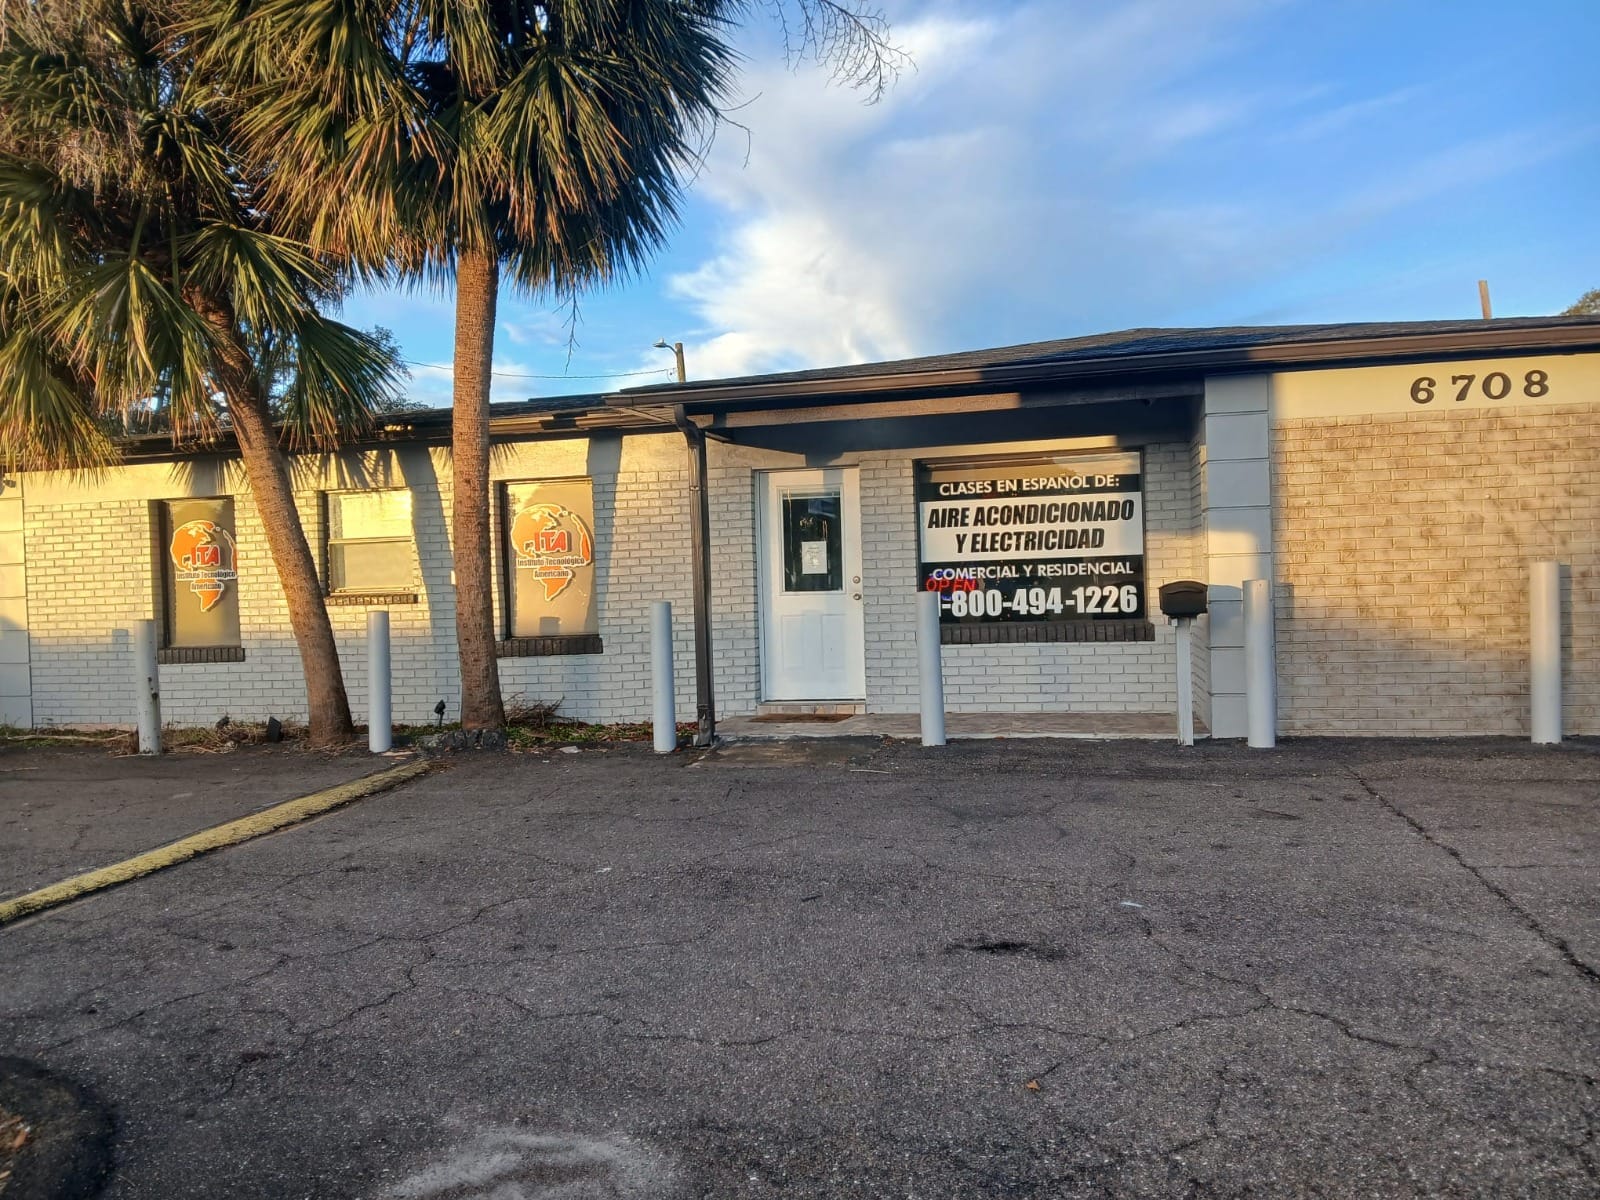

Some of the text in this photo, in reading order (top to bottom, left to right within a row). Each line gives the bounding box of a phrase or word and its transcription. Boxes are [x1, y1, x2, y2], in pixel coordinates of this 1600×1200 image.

[1410, 369, 1549, 404] 6708
[939, 473, 1120, 496] CLASES EN ESPAÑOL DE:
[928, 499, 1134, 529] AIRE ACONDICIONADO
[534, 531, 567, 552] ITA
[955, 528, 1105, 553] Y ELECTRICIDAD
[191, 545, 220, 566] ITA
[517, 559, 545, 567] Instituto
[534, 570, 569, 578] Americano
[932, 562, 1134, 580] COMERCIAL Y RESIDENCIAL
[939, 585, 1138, 617] -800-494-1226
